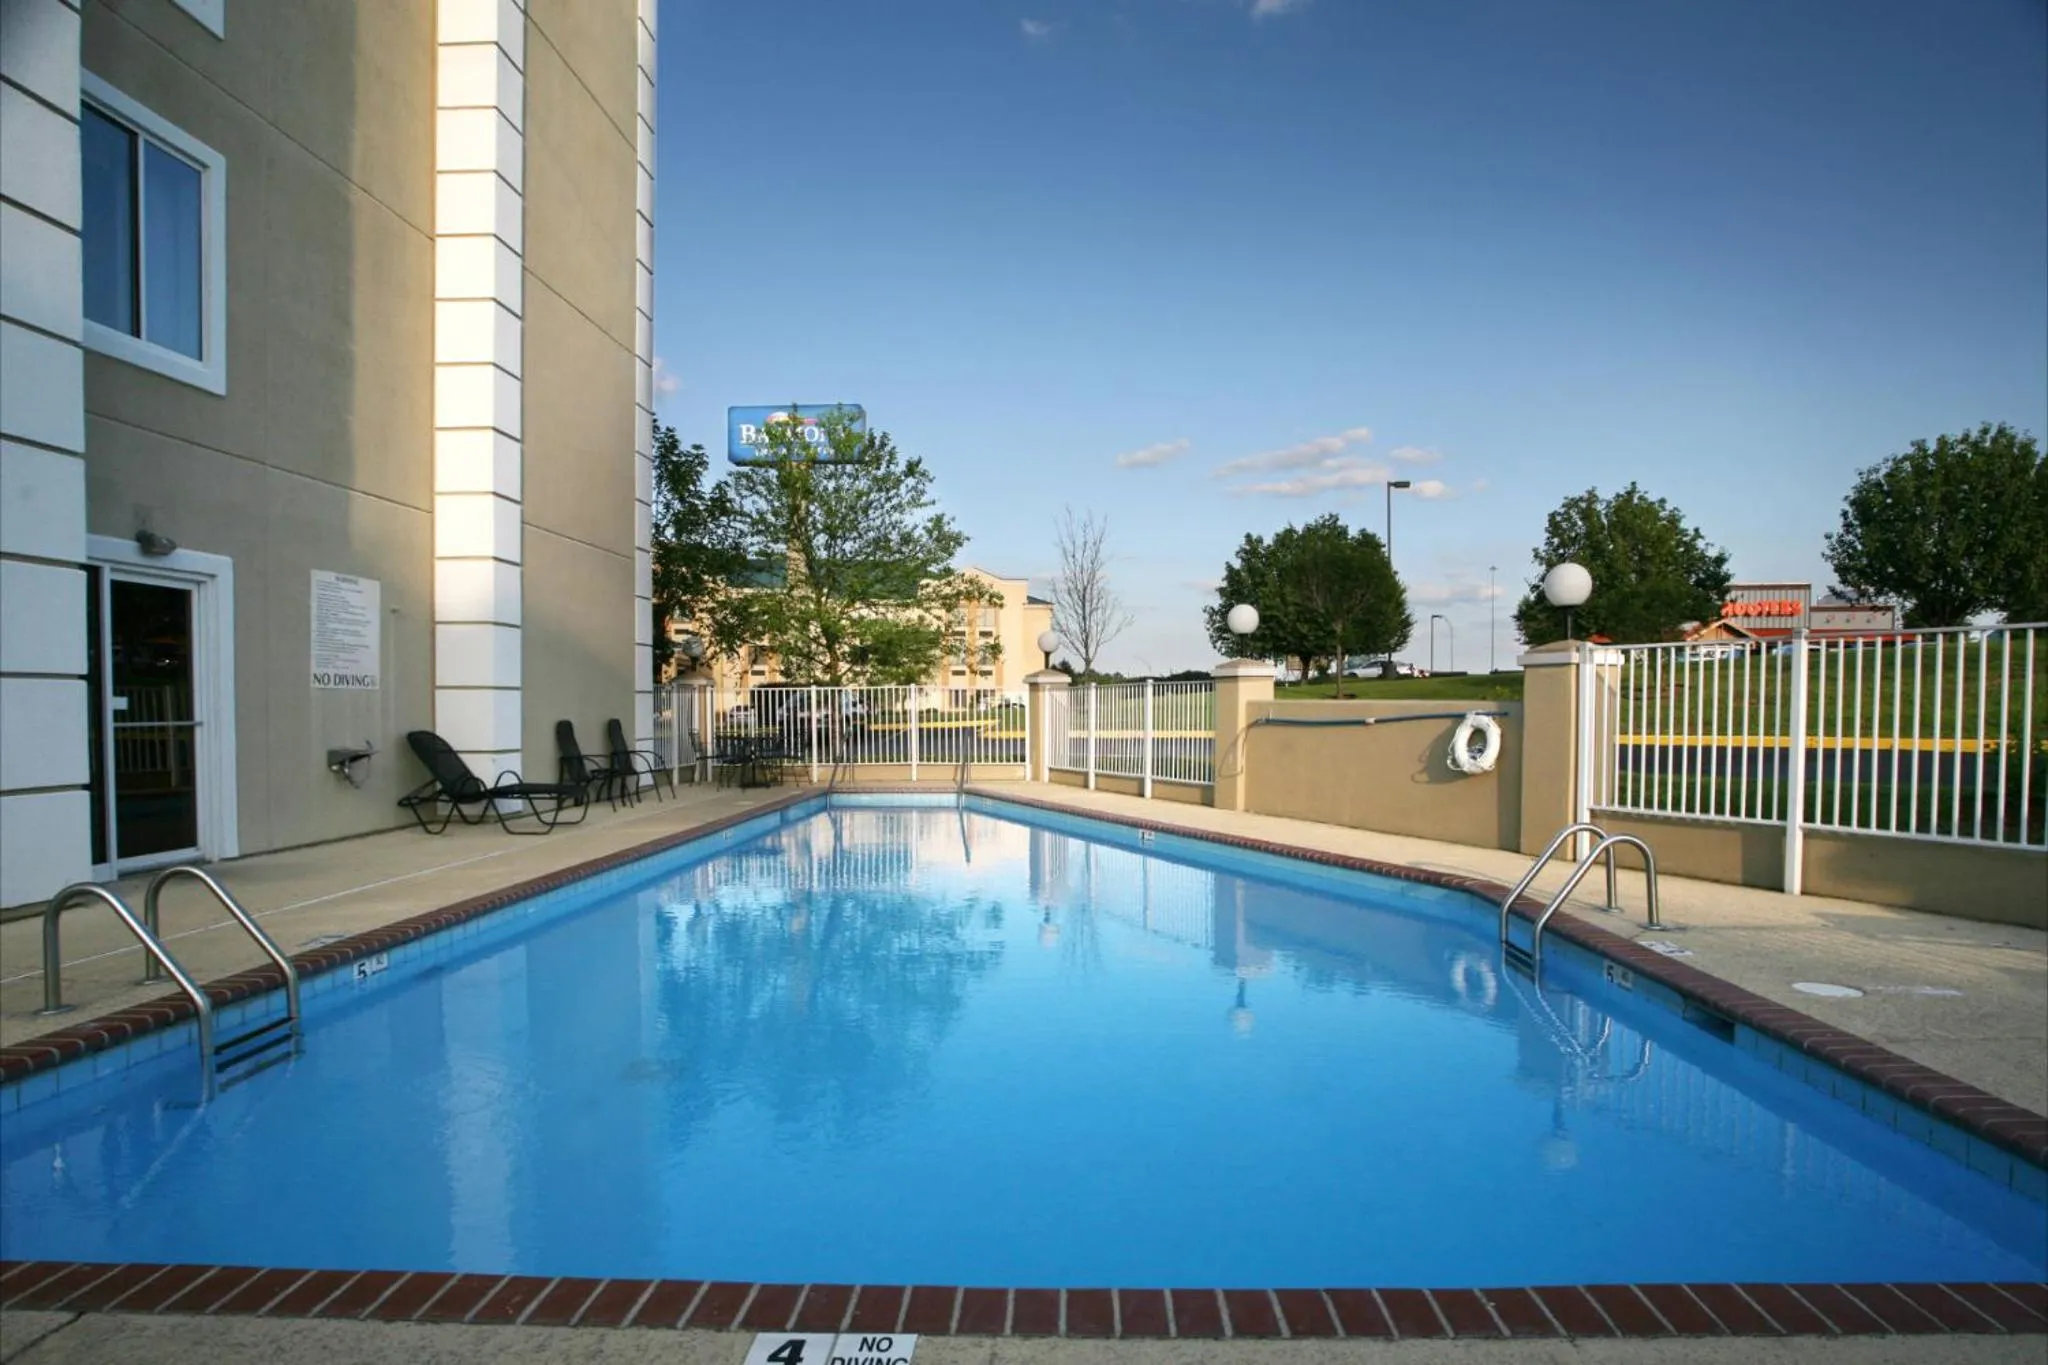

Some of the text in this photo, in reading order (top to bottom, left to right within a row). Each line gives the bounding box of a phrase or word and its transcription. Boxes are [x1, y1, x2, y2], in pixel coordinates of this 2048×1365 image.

[313, 672, 331, 686] NO
[333, 673, 370, 688] DIVING
[767, 1339, 807, 1365] 4
[858, 1336, 893, 1353] NO
